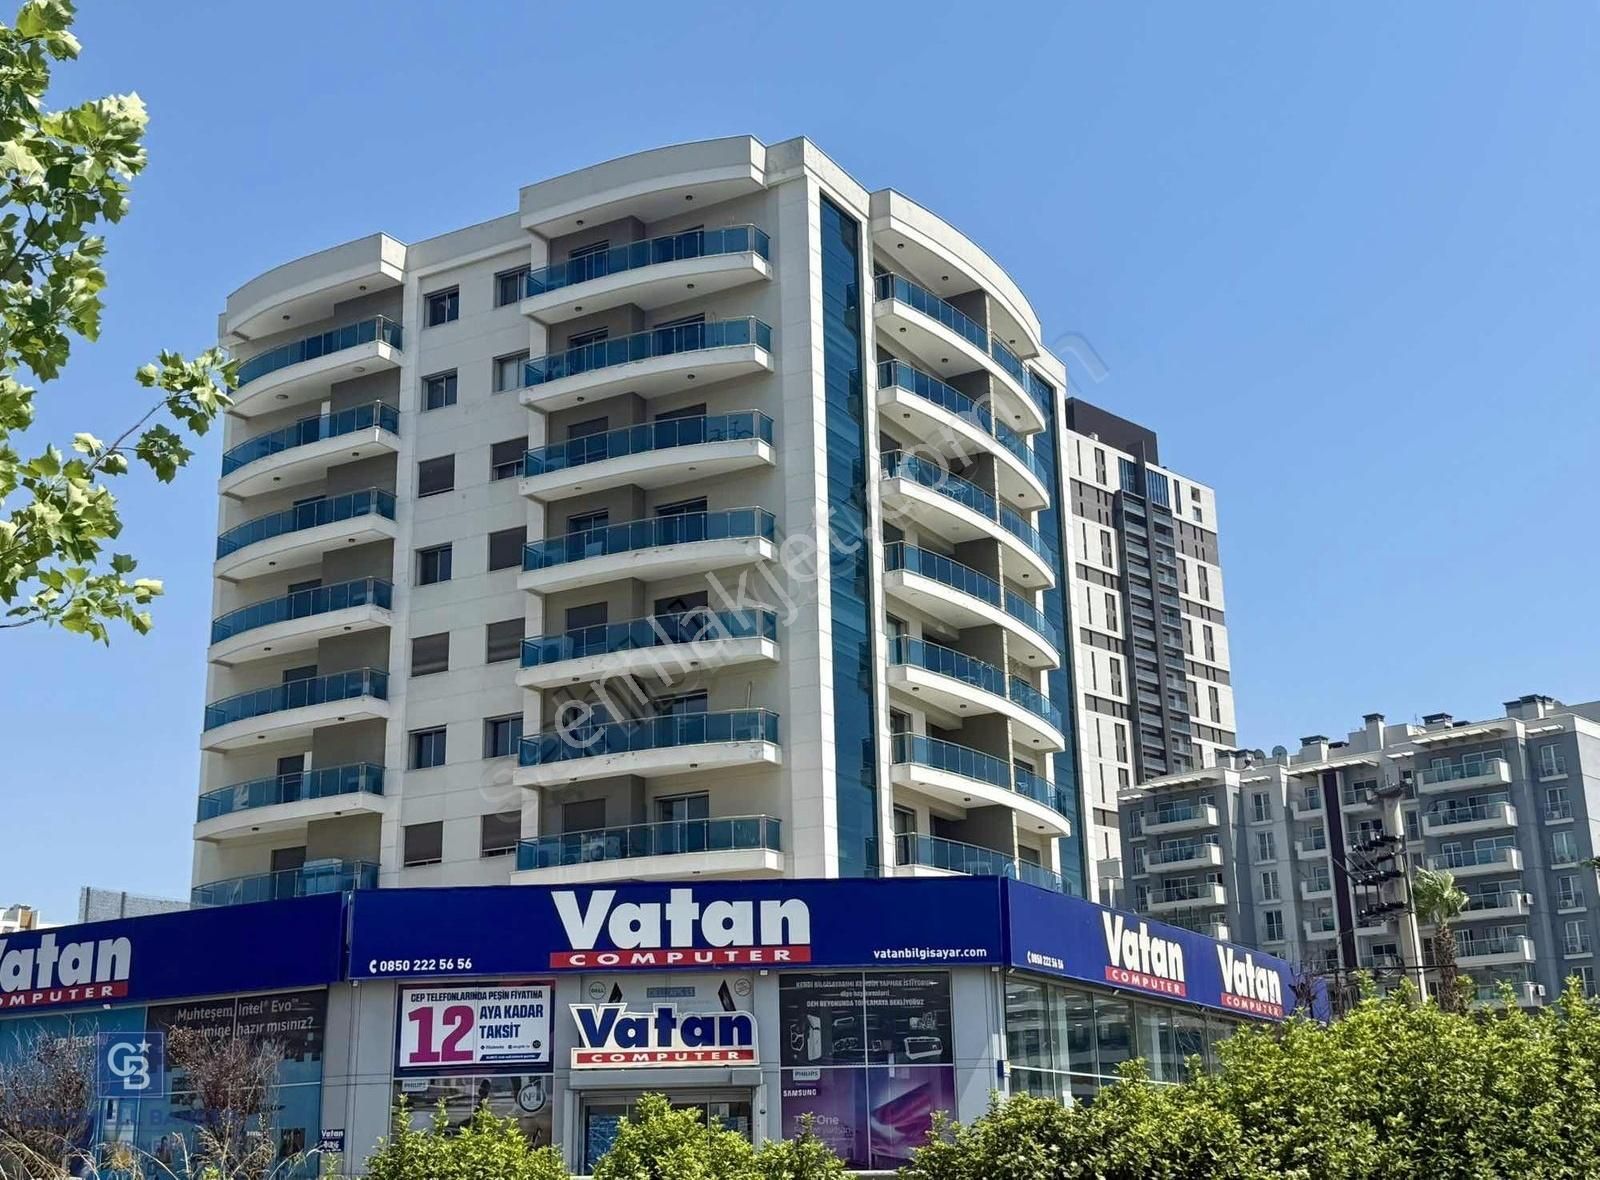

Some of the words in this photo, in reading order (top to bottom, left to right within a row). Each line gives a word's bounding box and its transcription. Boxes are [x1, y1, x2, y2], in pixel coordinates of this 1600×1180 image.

[551, 888, 811, 950] Vatan
[873, 946, 987, 960] vatanbilgisayar.com
[1102, 911, 1185, 982] Vatan
[380, 960, 410, 972] 0850
[413, 959, 436, 971] 222
[439, 958, 454, 970] 56
[457, 957, 472, 969] 56
[569, 950, 791, 966] COMPUTER
[1112, 969, 1182, 995] COMPUTER
[1217, 944, 1282, 1006] Vatan
[411, 993, 425, 1002] CEP
[427, 991, 487, 1001] TELEFONLARINDA
[488, 989, 510, 1001] PEŞİN
[511, 989, 543, 999] FİYATINA
[177, 1006, 233, 1021] Muhteşem
[480, 1005, 501, 1020] AYA
[504, 1004, 543, 1019] KADAR
[1226, 995, 1280, 1018] COMPUTER
[237, 1022, 264, 1036] hazır
[267, 1016, 314, 1032] mısınız?
[408, 1005, 474, 1063] 12
[480, 1022, 520, 1039] TAKSİT
[575, 1006, 753, 1049] Vatan
[591, 1051, 740, 1062] COMPUTER
[782, 1089, 817, 1097] SAMSUNG
